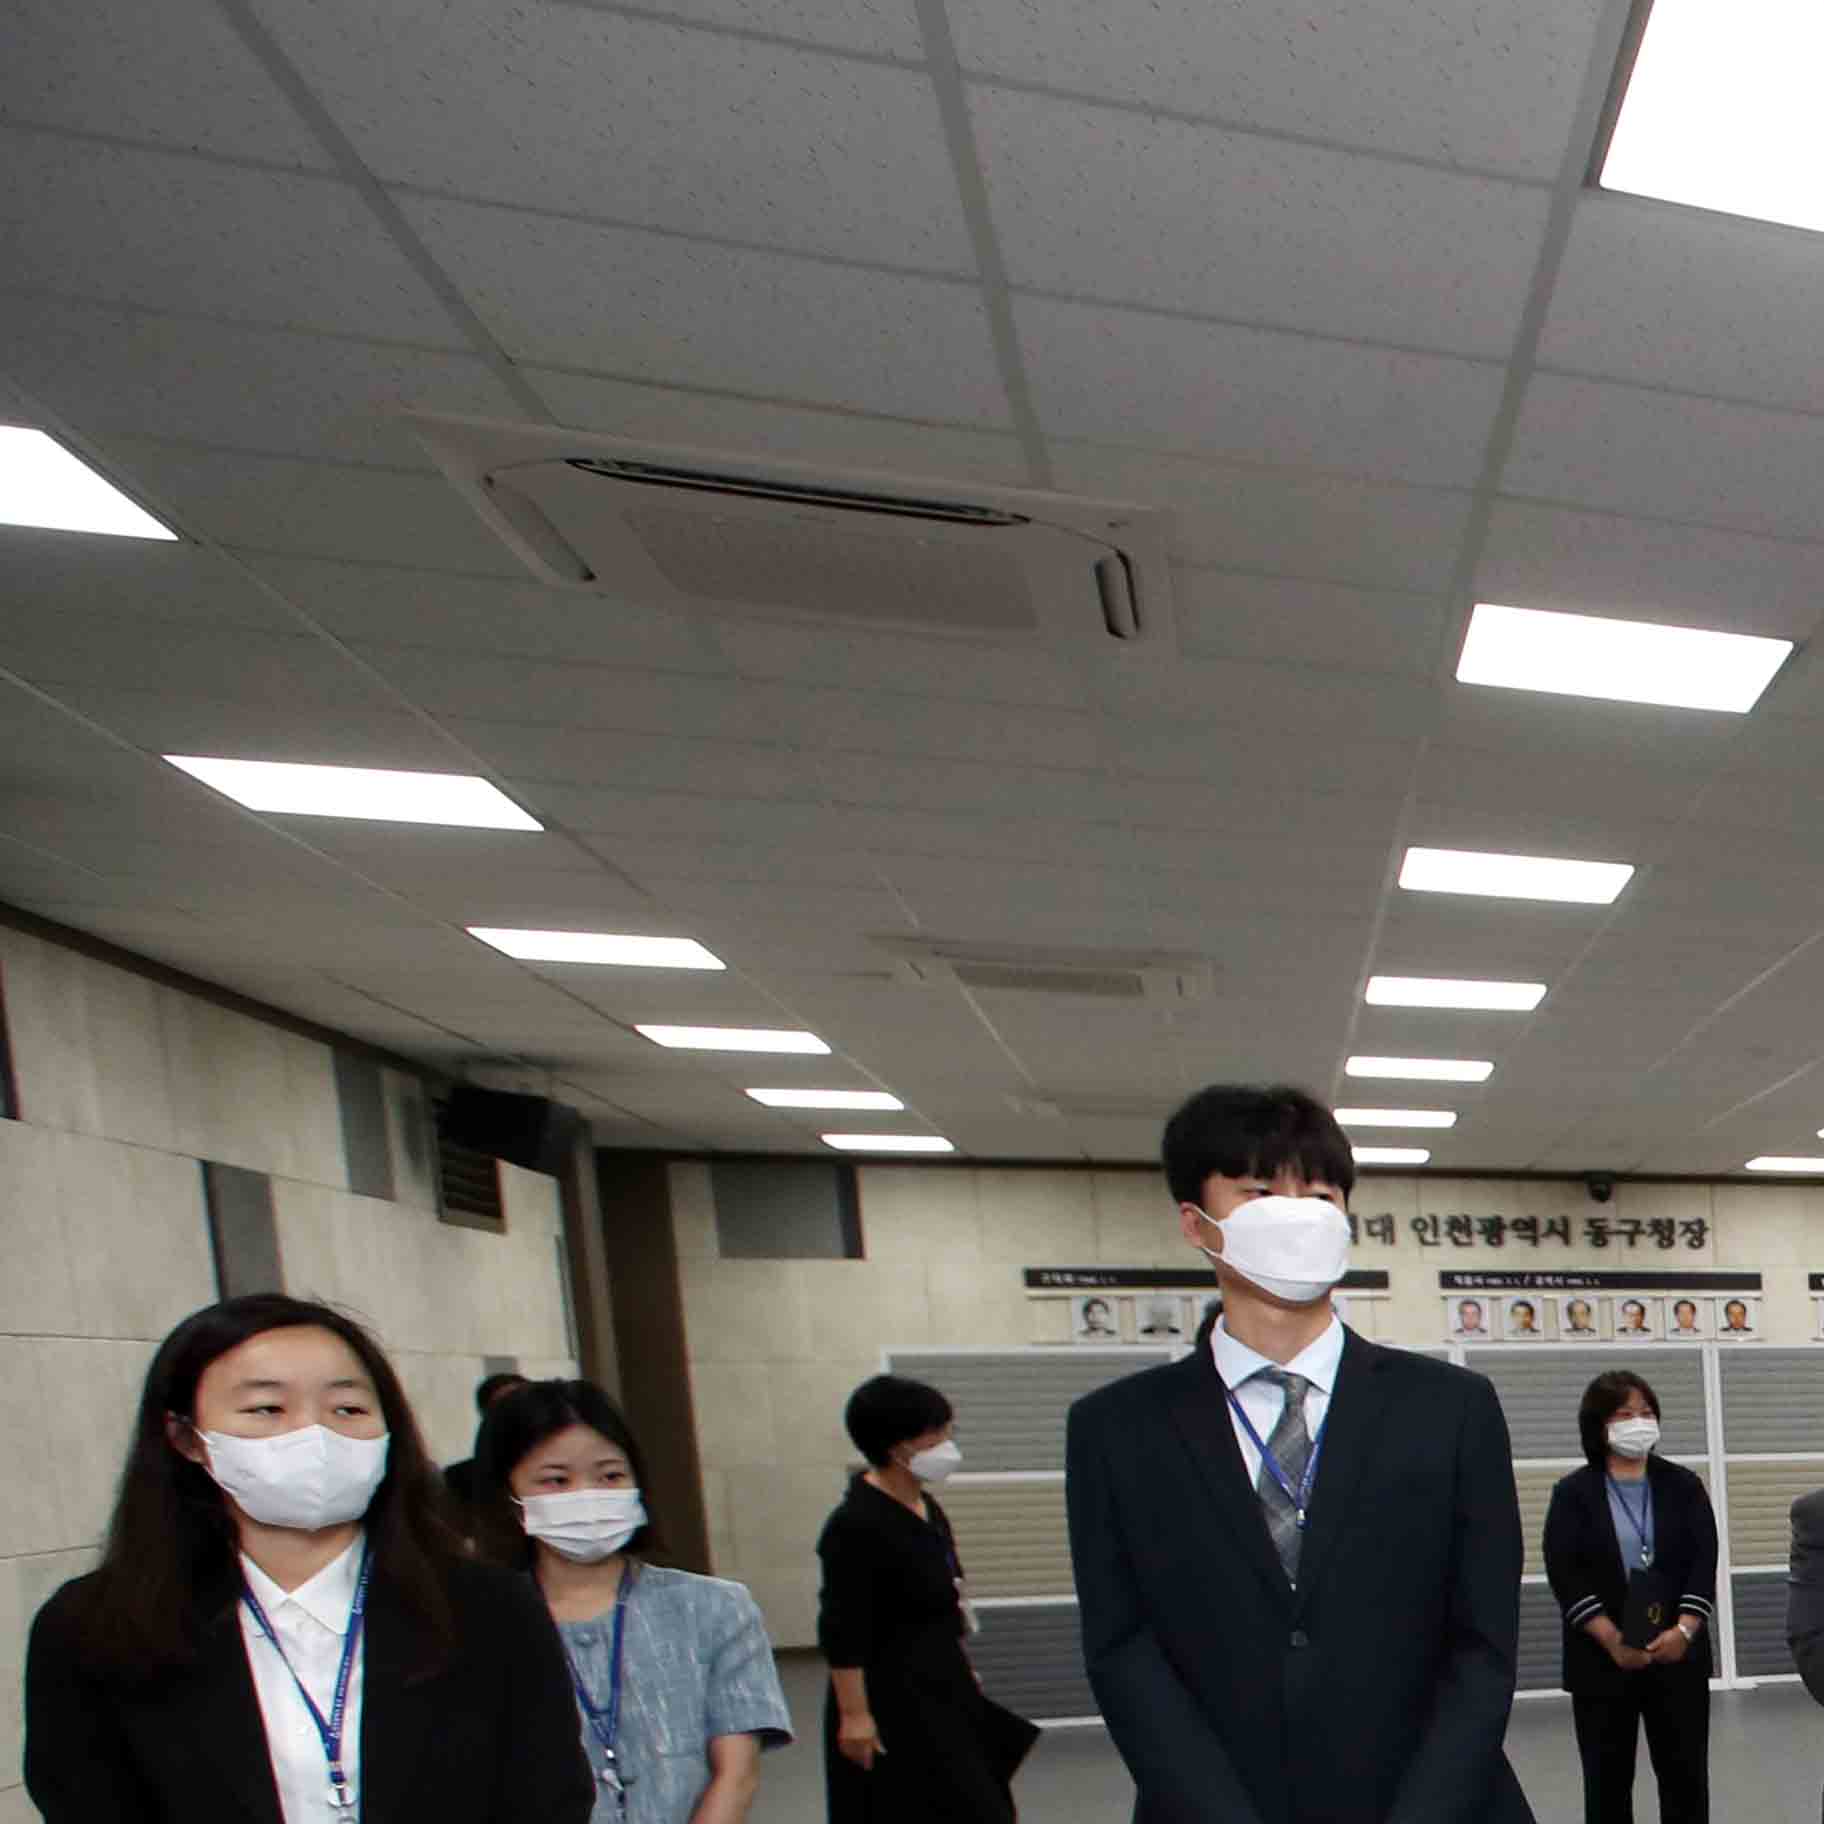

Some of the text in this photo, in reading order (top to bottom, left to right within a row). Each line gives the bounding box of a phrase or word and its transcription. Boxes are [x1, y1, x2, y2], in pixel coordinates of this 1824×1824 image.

[1350, 1213, 1710, 1250] 대 인천광역시 동구청장
